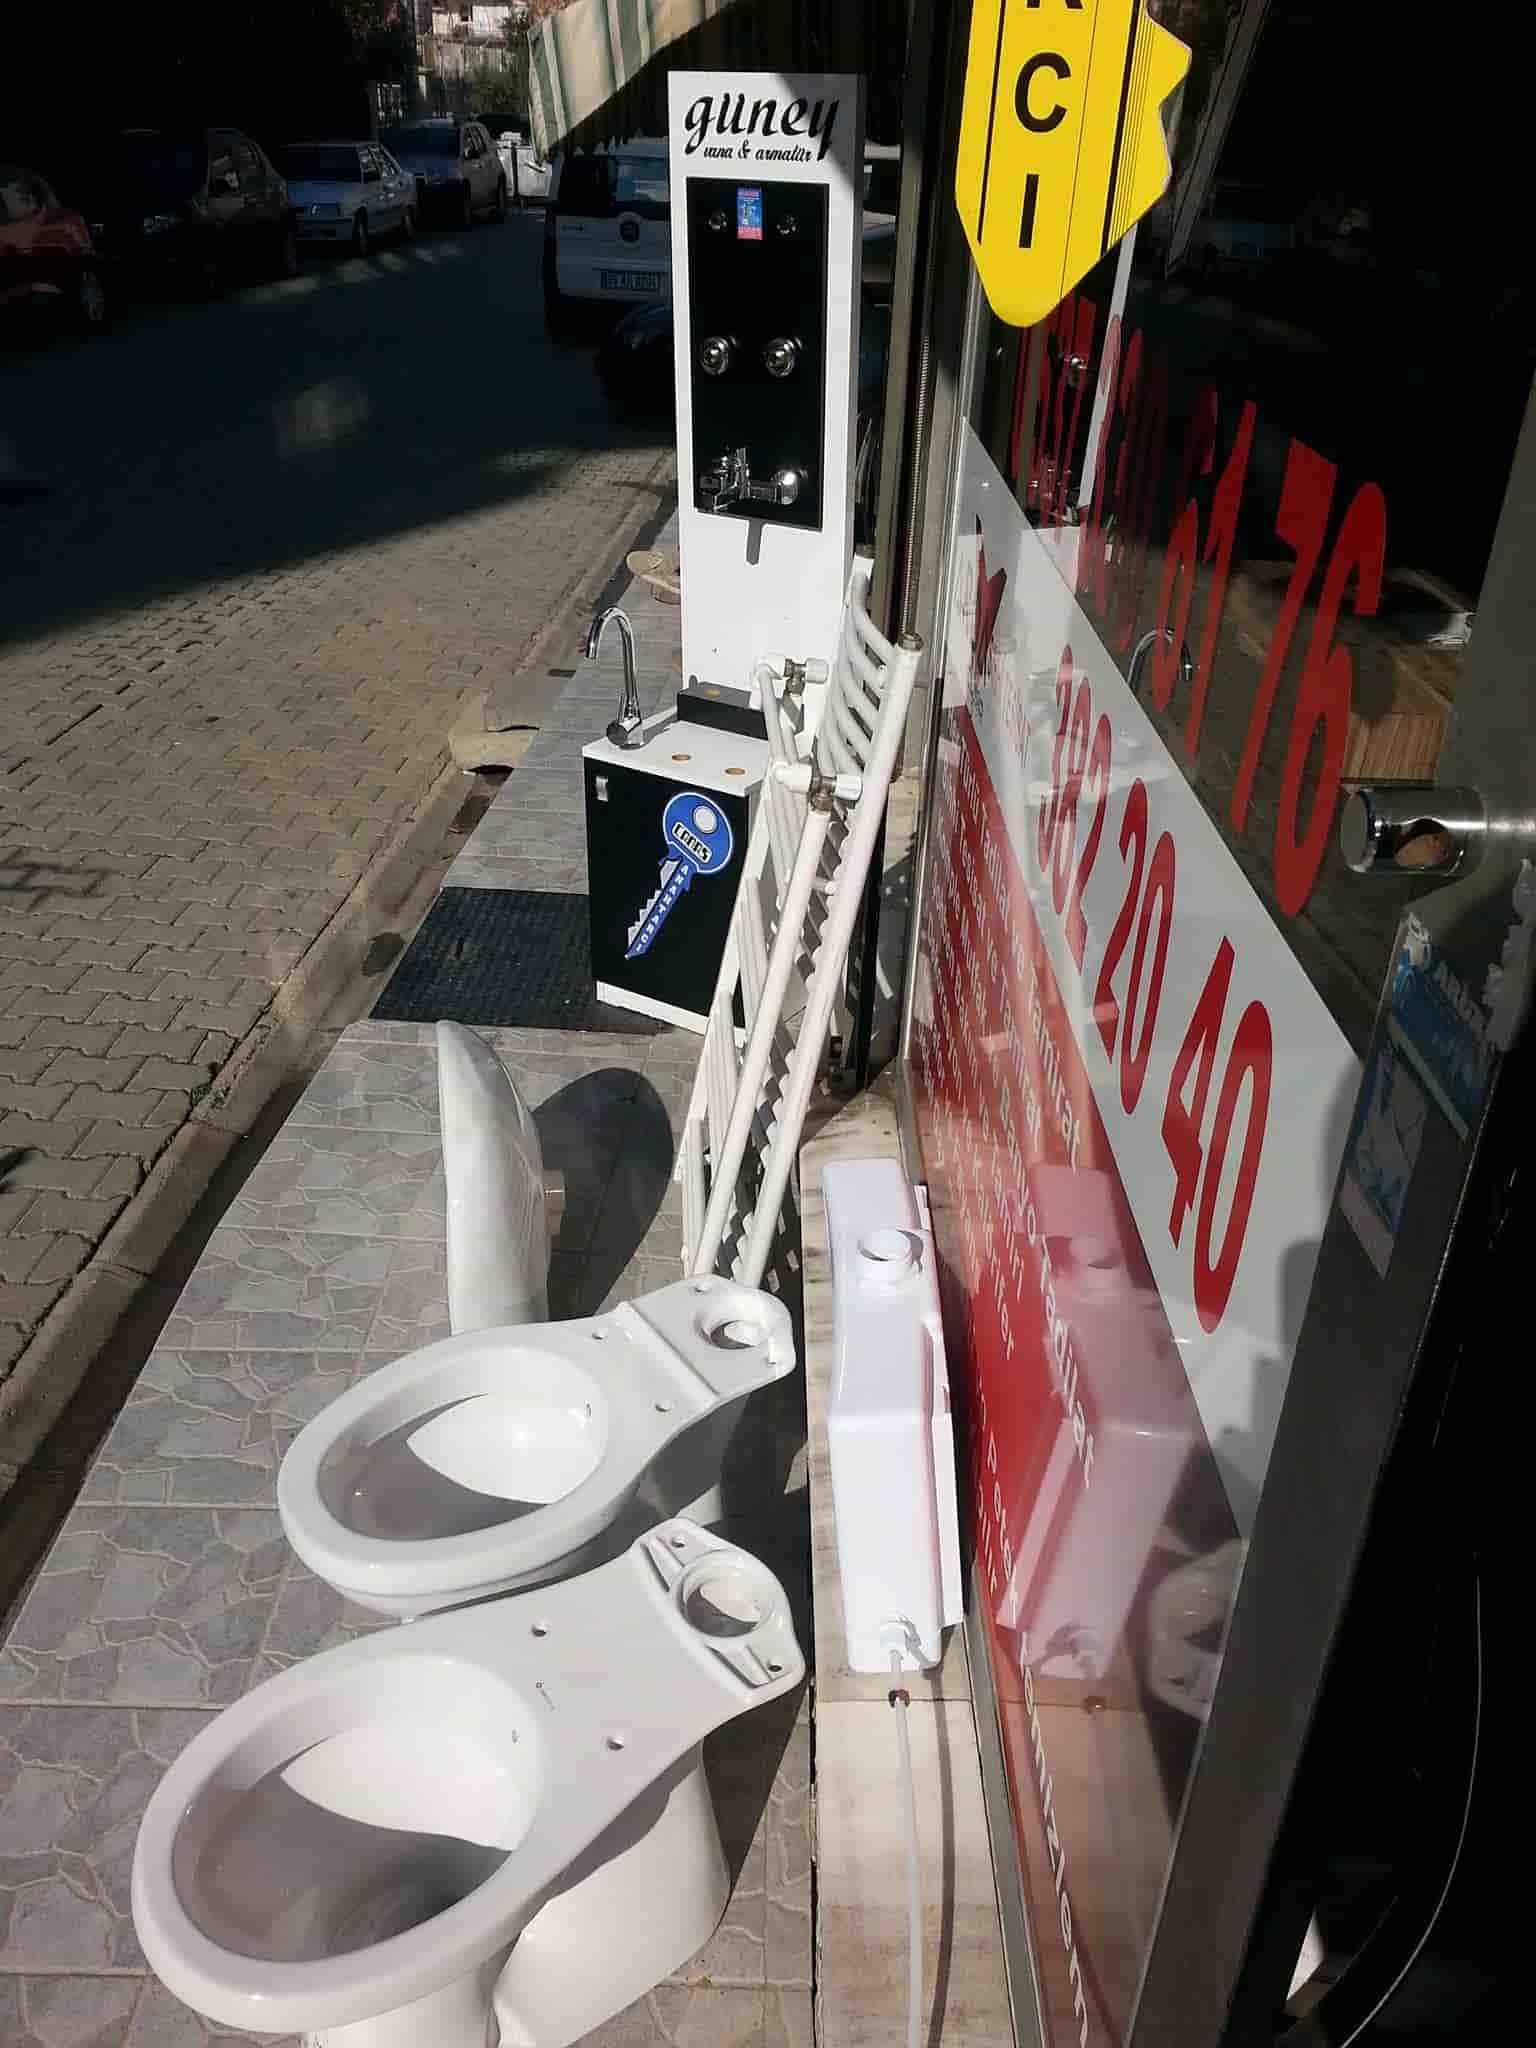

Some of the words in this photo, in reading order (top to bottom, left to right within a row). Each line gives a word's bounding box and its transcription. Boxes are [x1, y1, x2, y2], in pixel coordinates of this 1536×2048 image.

[684, 92, 840, 161] güney
[737, 139, 751, 159] &
[1014, 0, 1084, 249] CI
[1150, 384, 1256, 762] 61
[1231, 437, 1387, 917] 76
[959, 813, 986, 938] Tesisat
[986, 927, 998, 984] ve
[1000, 966, 1041, 1154] Tamirat
[981, 802, 1009, 938] Tadilat
[1011, 917, 1025, 981] ve
[1029, 960, 1080, 1172] Tamirat
[1039, 643, 1112, 975] 382
[1093, 777, 1175, 1115] 20
[1161, 935, 1272, 1333] 40
[960, 907, 985, 1024] Mutfak
[1001, 1075, 1036, 1247] Banyo
[1040, 1233, 1094, 1490] Tadilat
[991, 1130, 1023, 1302] Tamiri
[987, 1430, 1018, 1624] Petek
